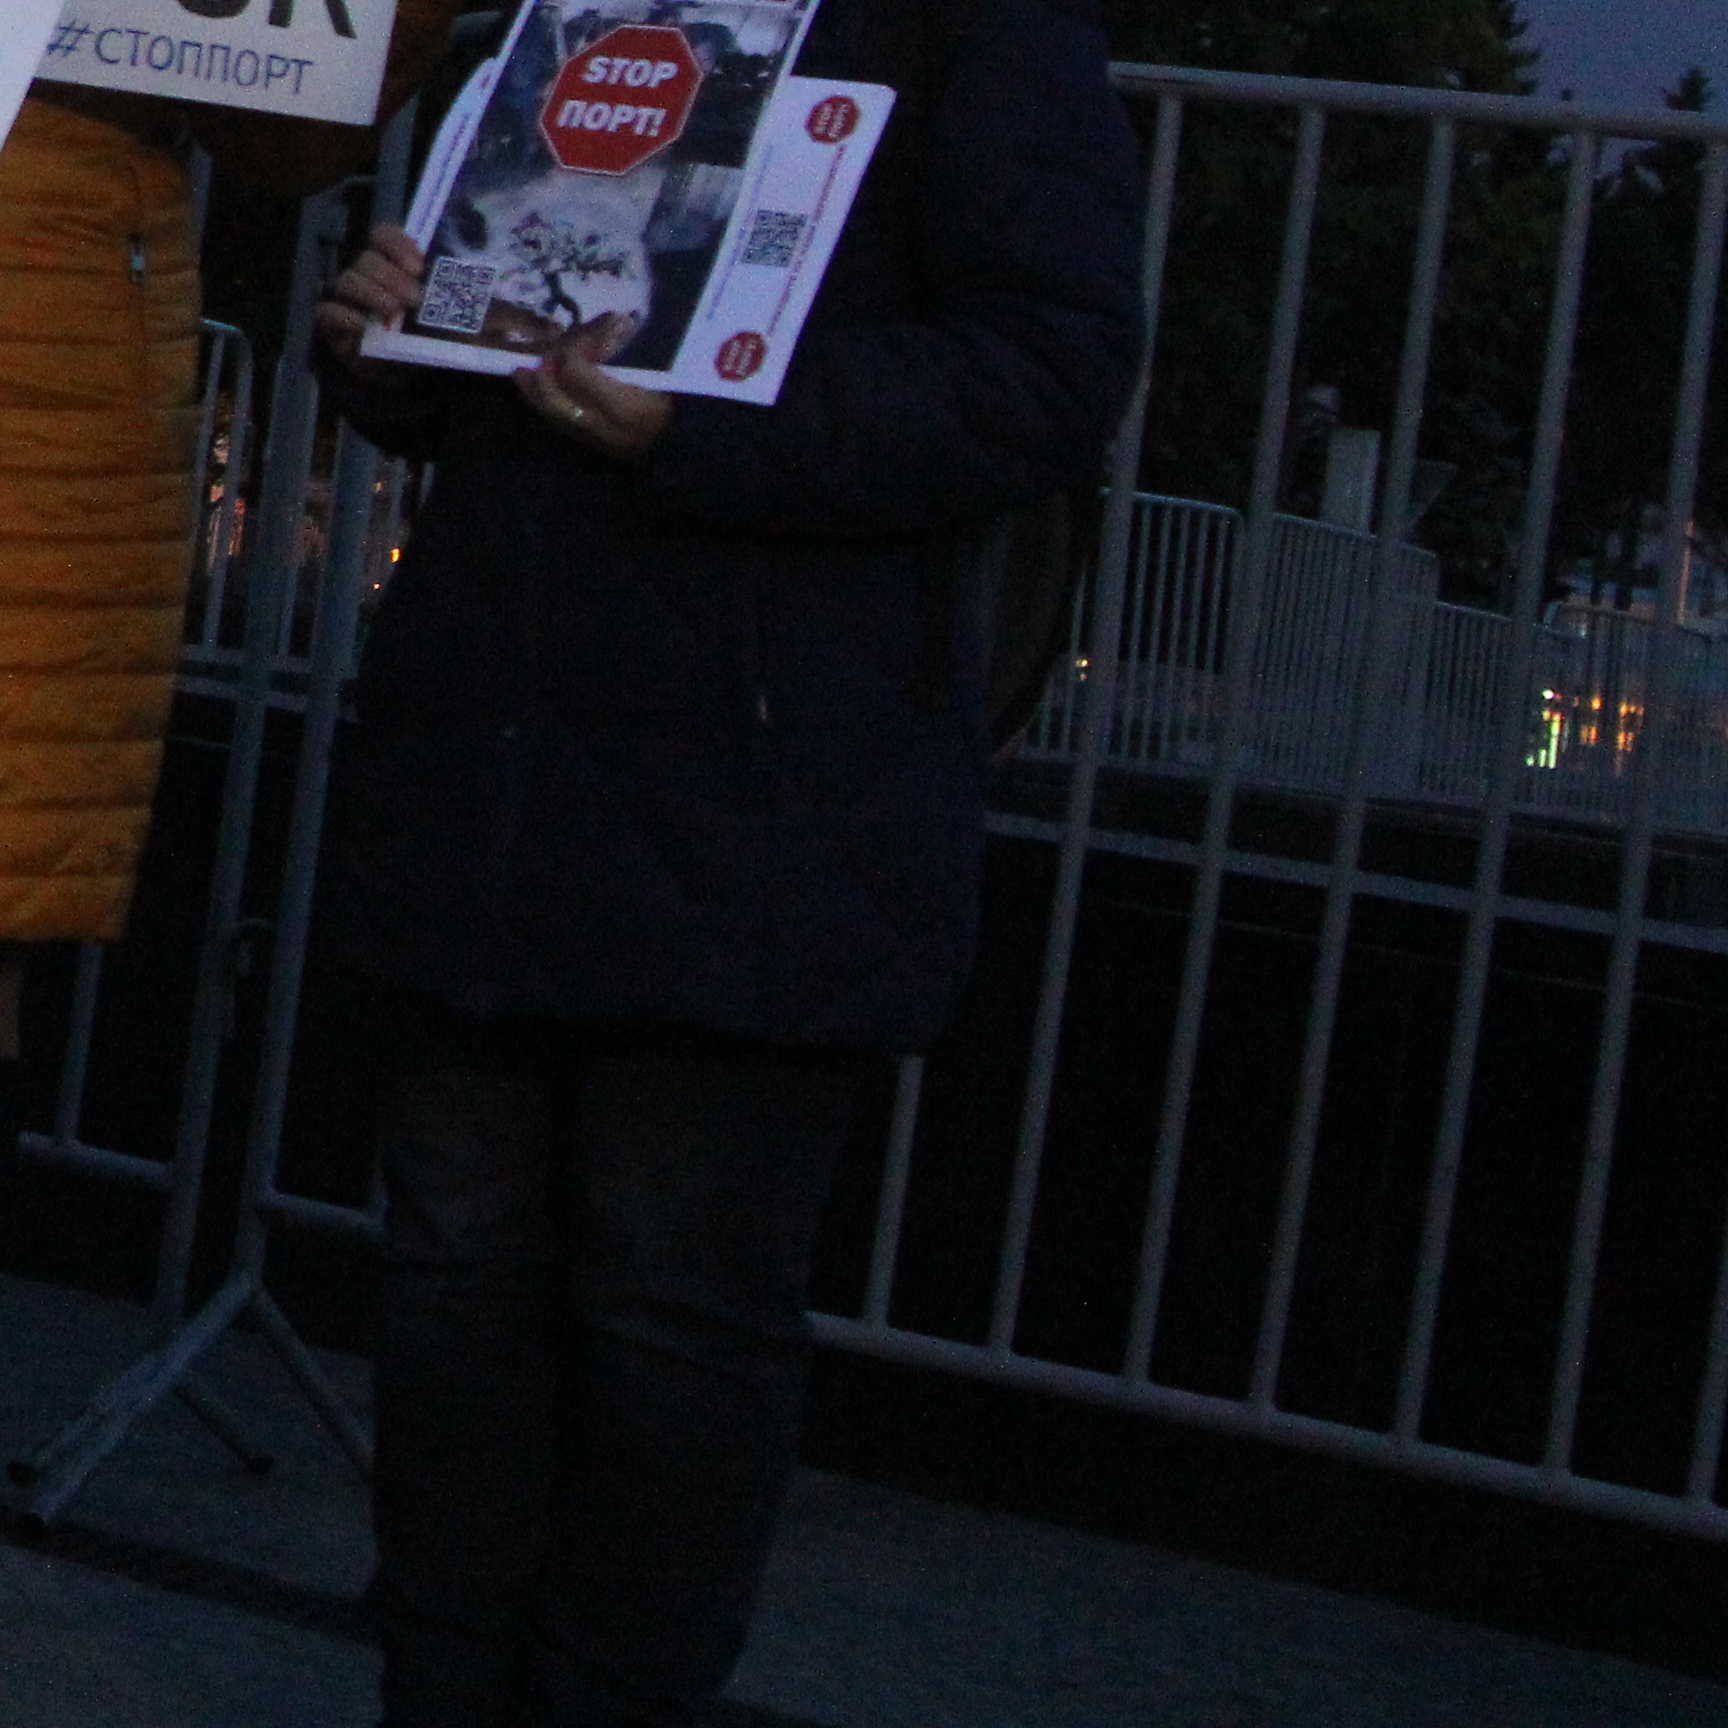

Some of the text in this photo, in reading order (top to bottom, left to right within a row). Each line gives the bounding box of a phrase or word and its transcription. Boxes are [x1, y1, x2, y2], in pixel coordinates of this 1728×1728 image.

[54, 20, 315, 95] #СТОППОРТ
[582, 55, 680, 89] STOP
[557, 99, 667, 138] ПОРТ!
